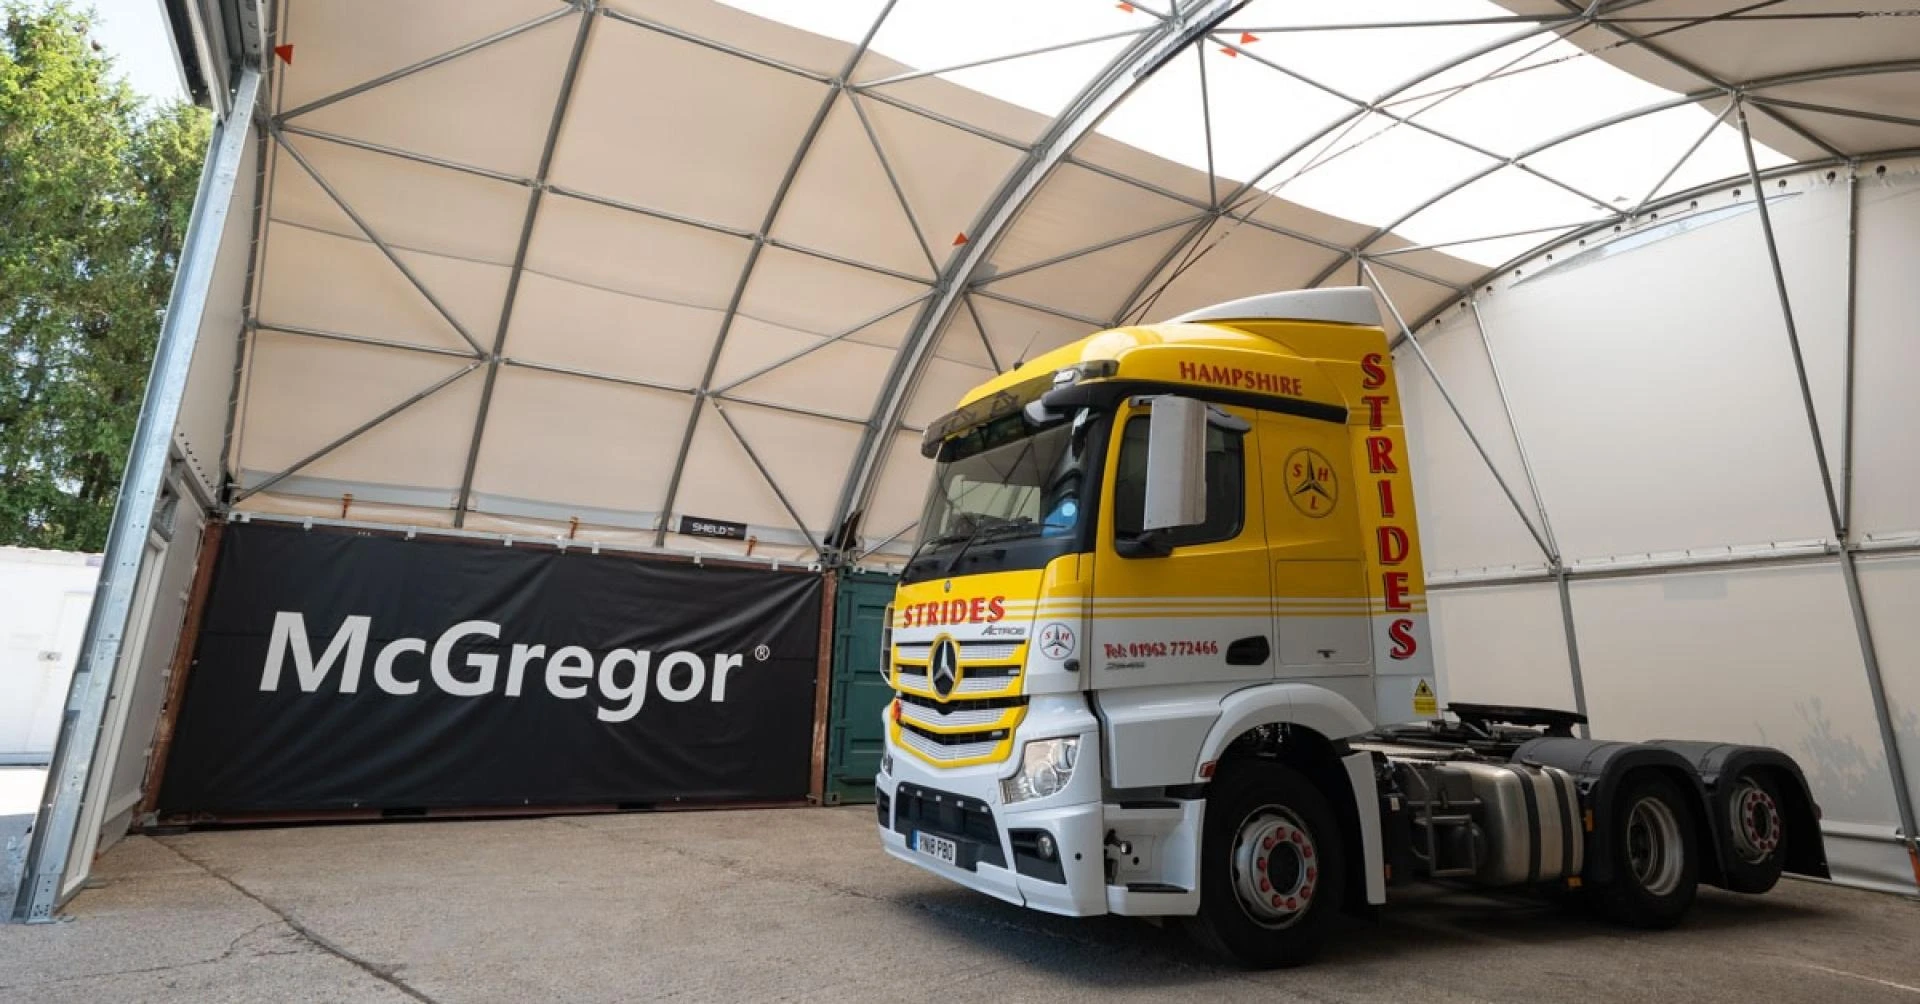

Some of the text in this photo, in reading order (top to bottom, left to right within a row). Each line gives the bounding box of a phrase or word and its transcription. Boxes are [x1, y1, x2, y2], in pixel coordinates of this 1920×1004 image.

[1179, 360, 1303, 396] HAMPSHIRE
[1361, 352, 1417, 661] STRIDES
[691, 521, 727, 535] SHIELD
[903, 595, 1006, 628] STRIDES
[260, 611, 742, 722] McGregor
[1103, 640, 1219, 659] Tel: 01962 772466
